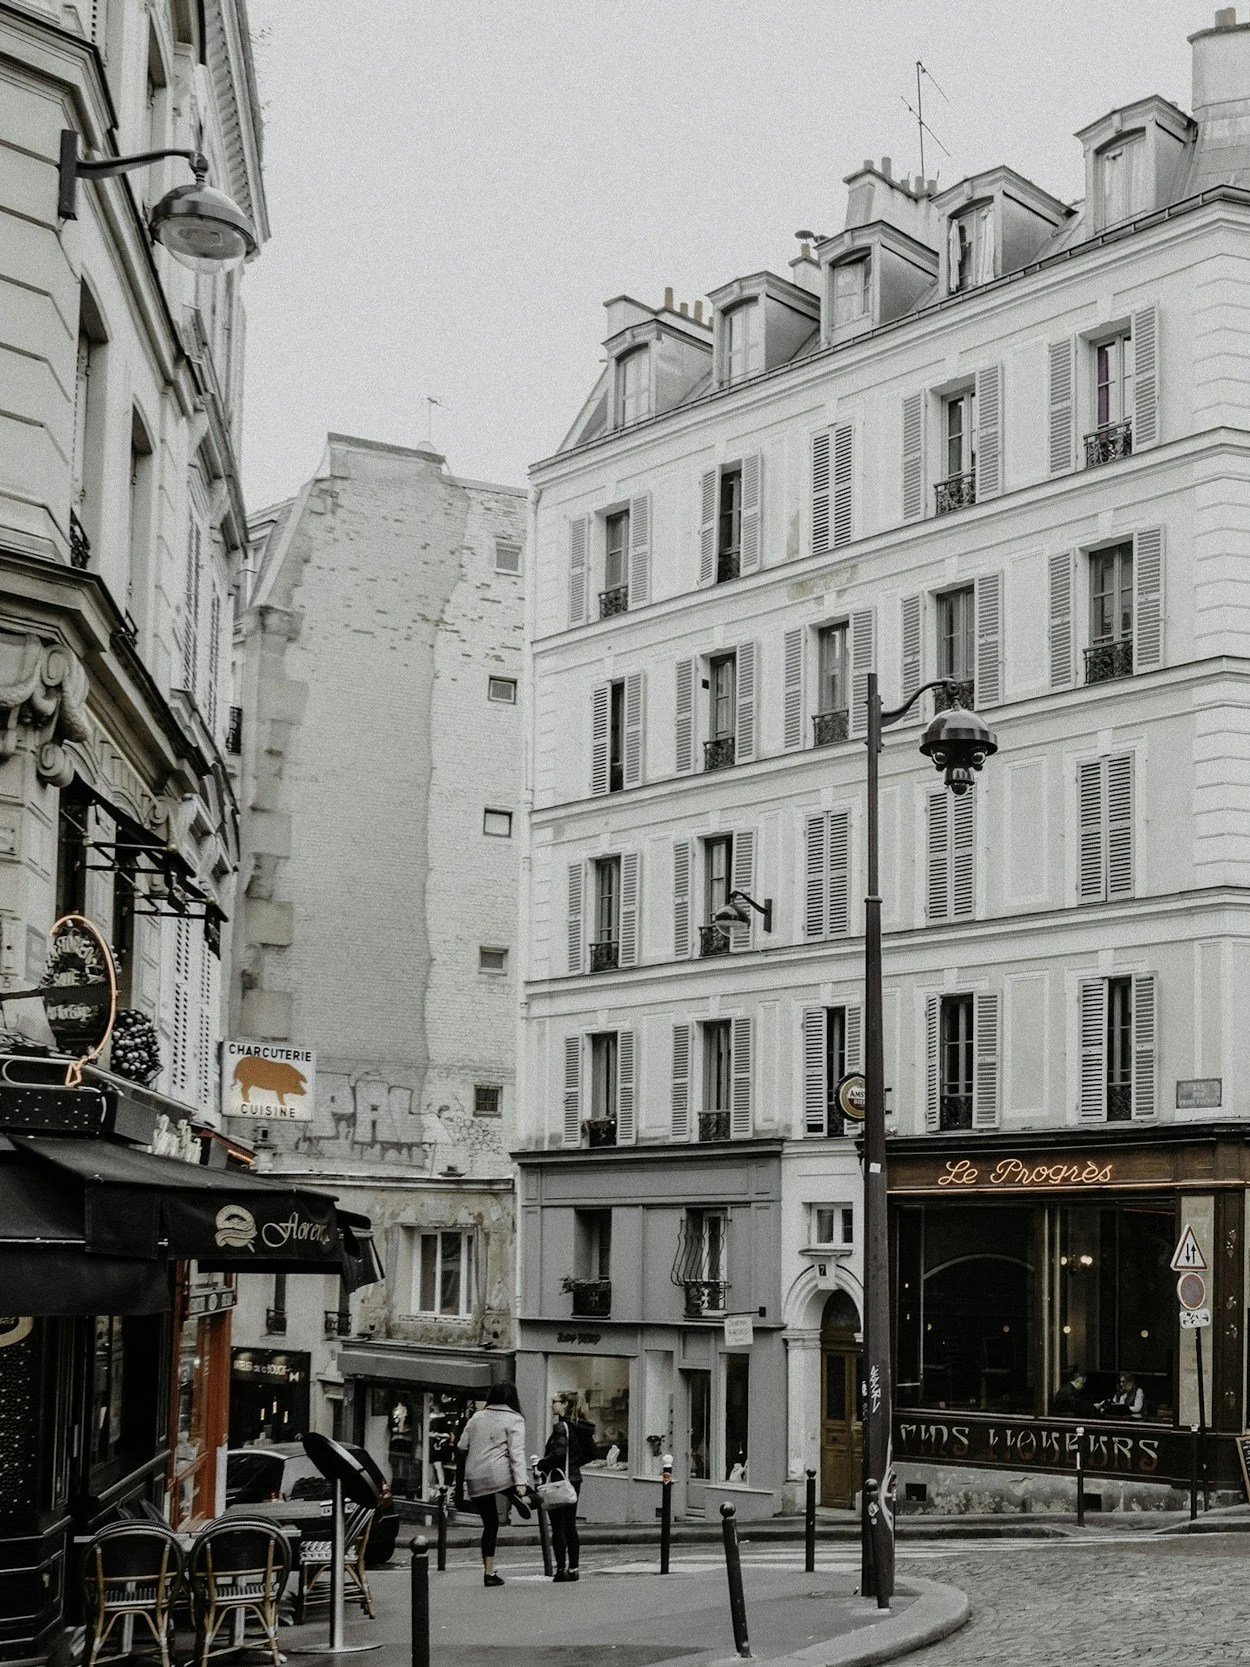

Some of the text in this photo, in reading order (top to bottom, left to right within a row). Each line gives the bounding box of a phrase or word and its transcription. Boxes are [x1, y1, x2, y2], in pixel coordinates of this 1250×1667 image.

[228, 1043, 312, 1062] CHARCUTERIE
[240, 1103, 296, 1118] CUISINE
[938, 1158, 1113, 1186] Le Progrès
